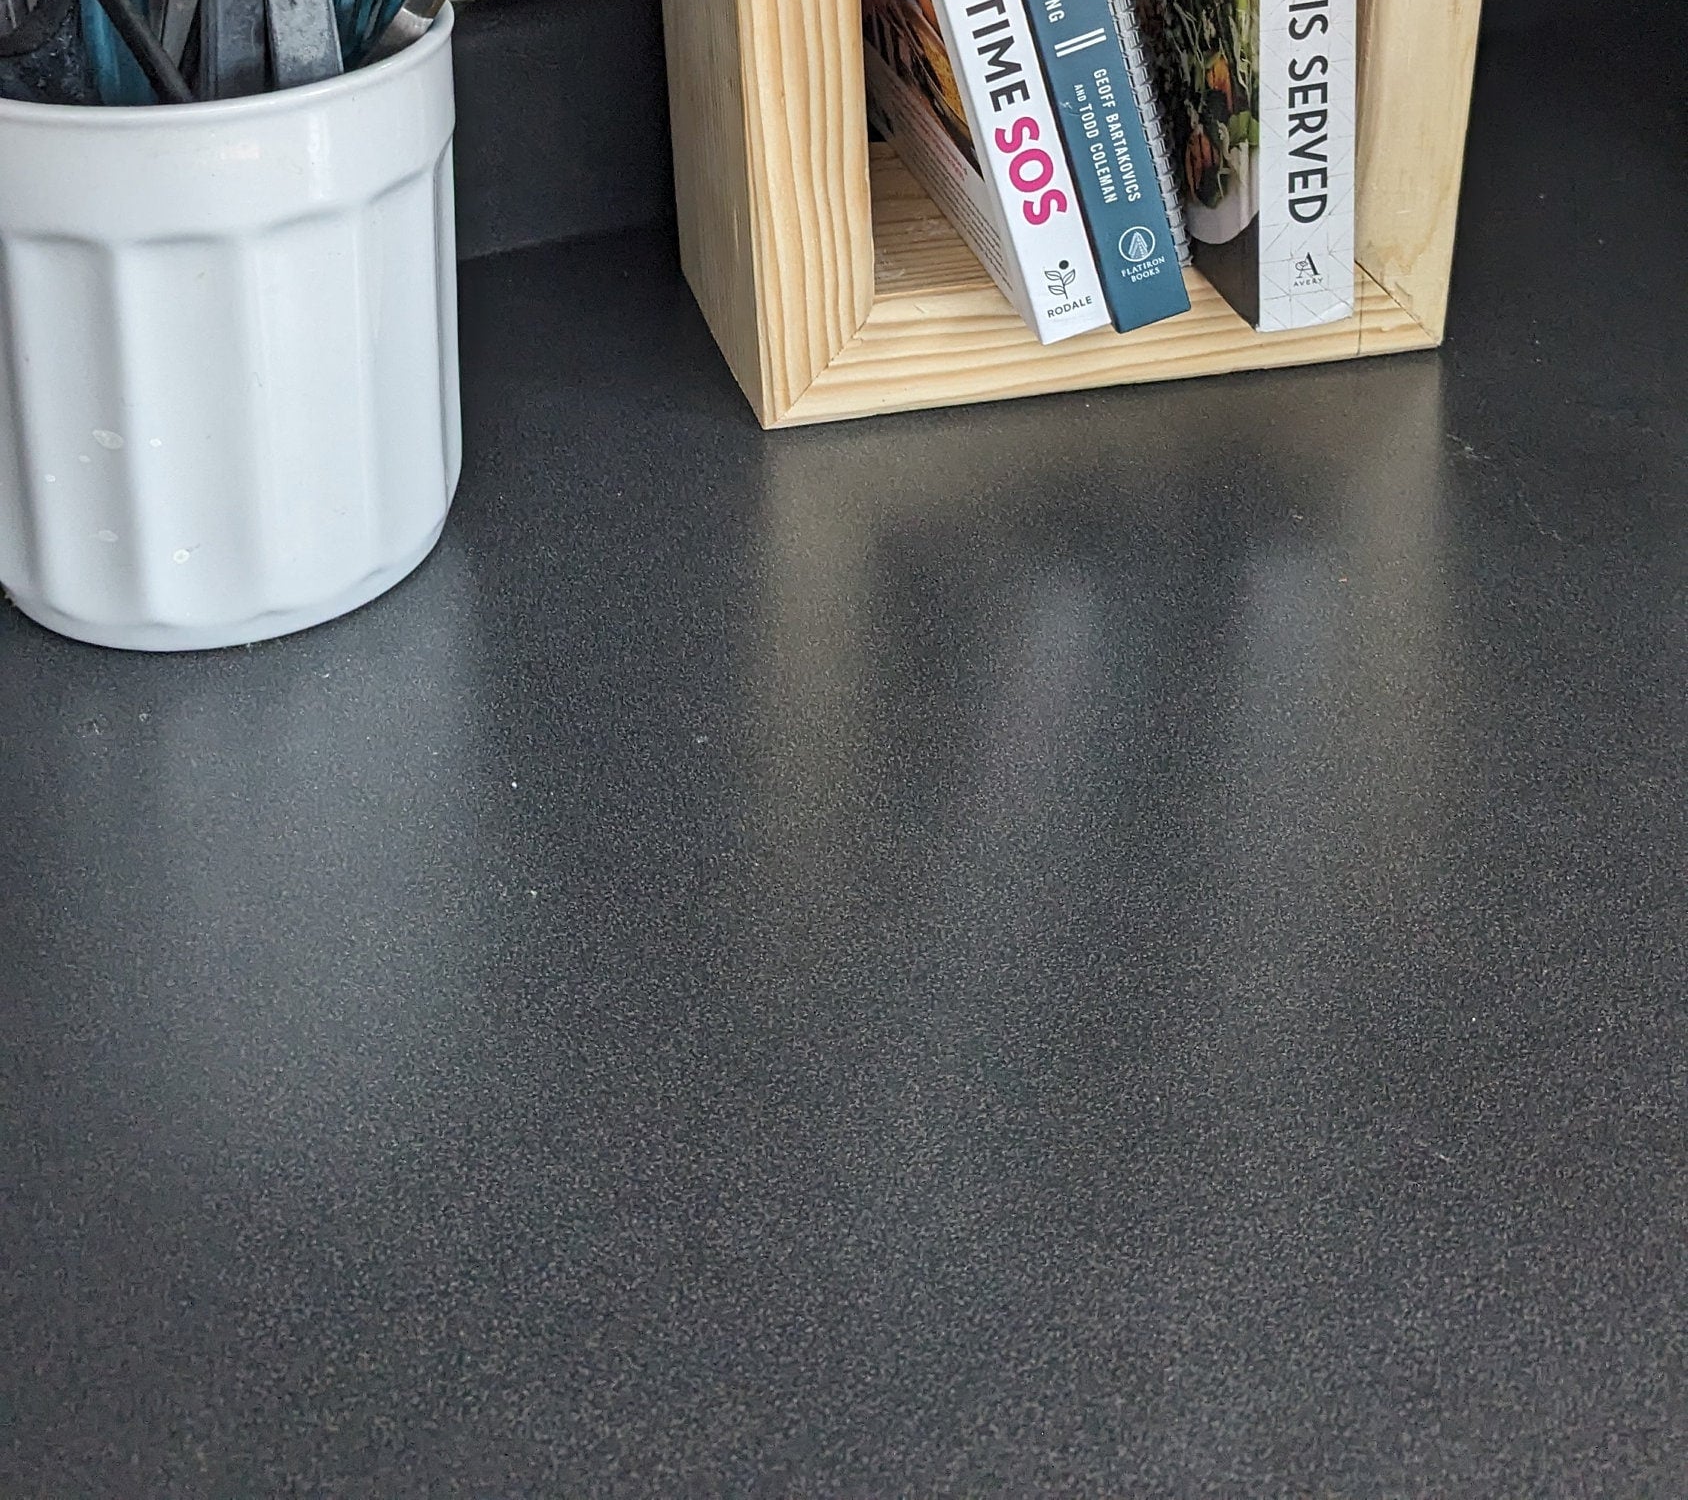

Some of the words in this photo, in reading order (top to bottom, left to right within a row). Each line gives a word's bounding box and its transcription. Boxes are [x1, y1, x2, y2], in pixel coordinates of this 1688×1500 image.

[1288, 0, 1329, 41] IS
[1074, 84, 1087, 102] AND
[1079, 104, 1097, 139] TODD
[1093, 68, 1116, 109] GEOFF
[1105, 113, 1141, 202] BARTAKOVICS
[1288, 54, 1329, 224] SERVED
[995, 116, 1067, 225] SOS
[1089, 142, 1117, 204] COLEMAN
[1121, 256, 1165, 277] FLATIRON
[1131, 267, 1161, 283] BOOKS
[1293, 277, 1323, 288] AVERY
[1047, 295, 1092, 318] RODALE
